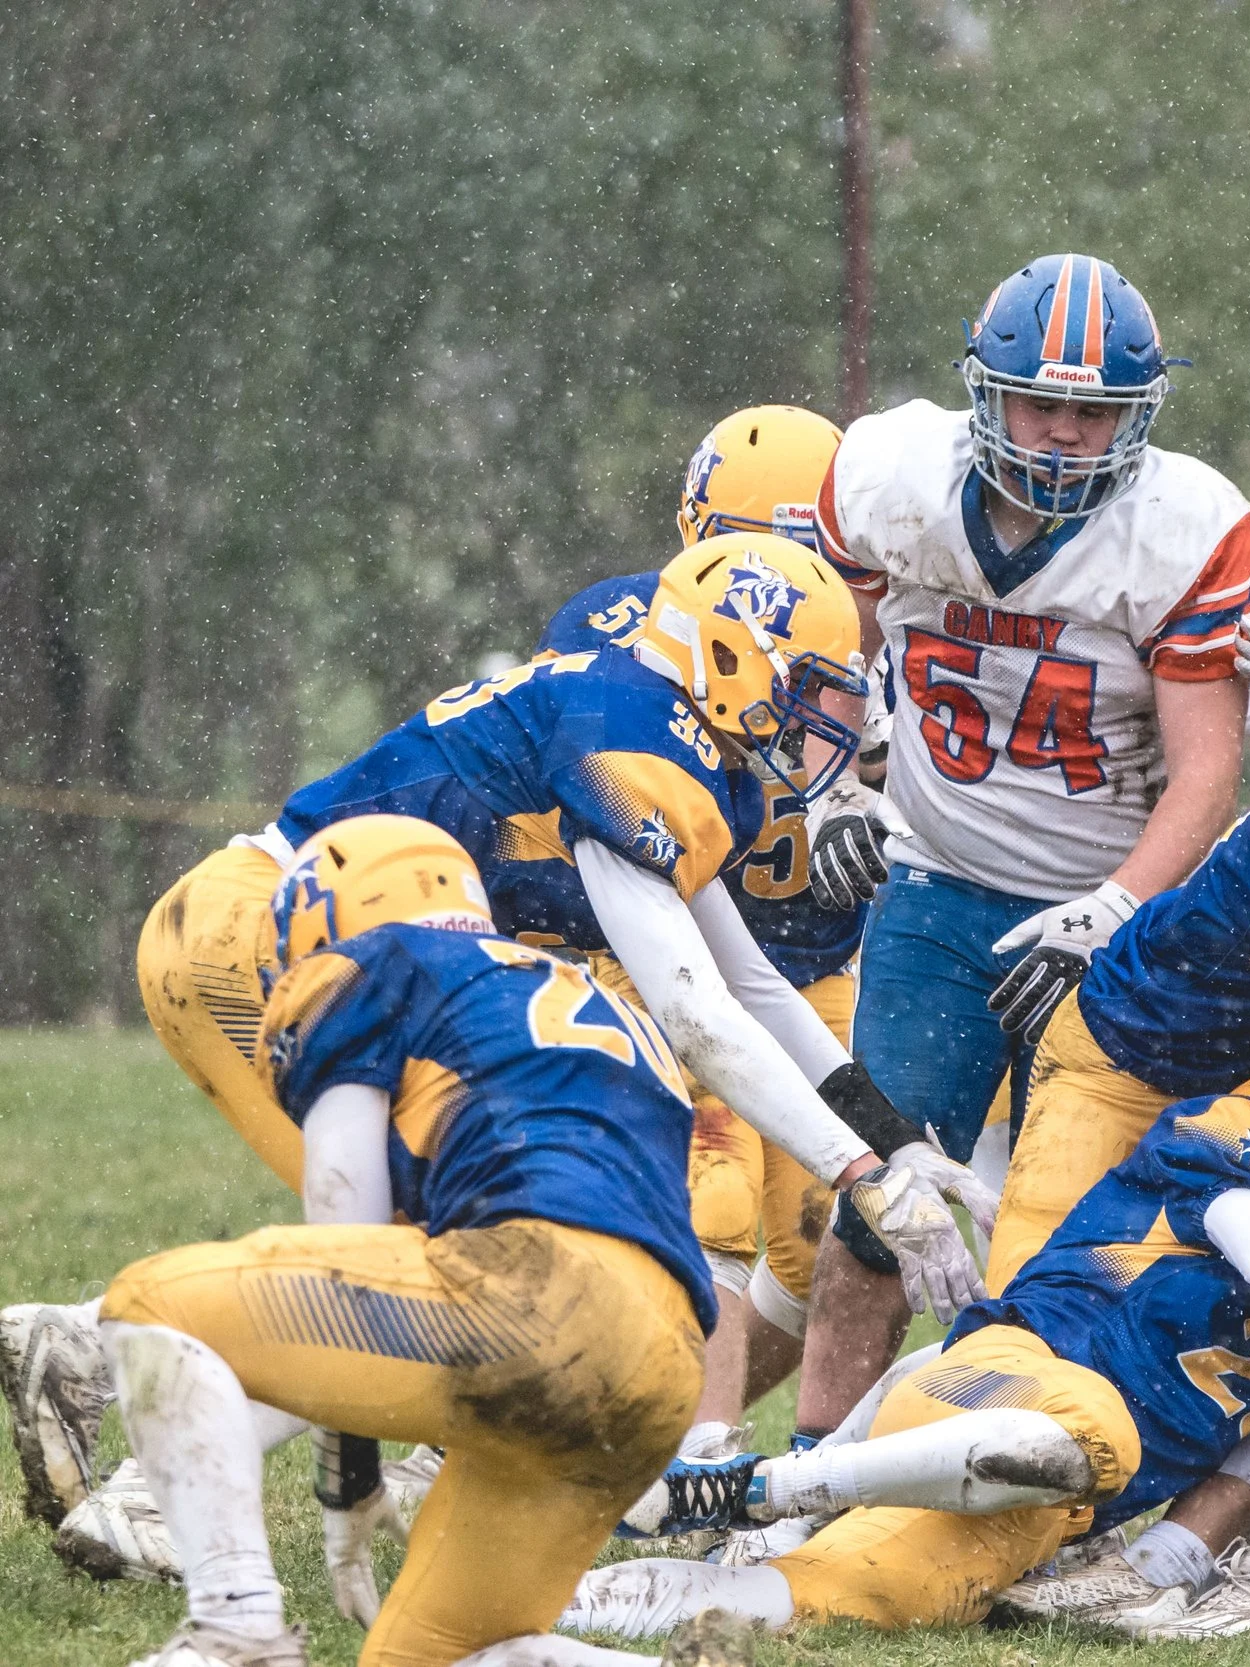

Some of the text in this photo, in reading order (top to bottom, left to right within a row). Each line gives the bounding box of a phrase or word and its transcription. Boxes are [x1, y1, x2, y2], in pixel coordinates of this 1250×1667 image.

[1046, 368, 1095, 383] Riddell
[789, 507, 815, 519] Ridd
[943, 600, 1069, 653] CANBY
[668, 701, 721, 771] 35
[902, 624, 1110, 797] 54
[742, 768, 813, 899] 5
[476, 938, 694, 1110] 20
